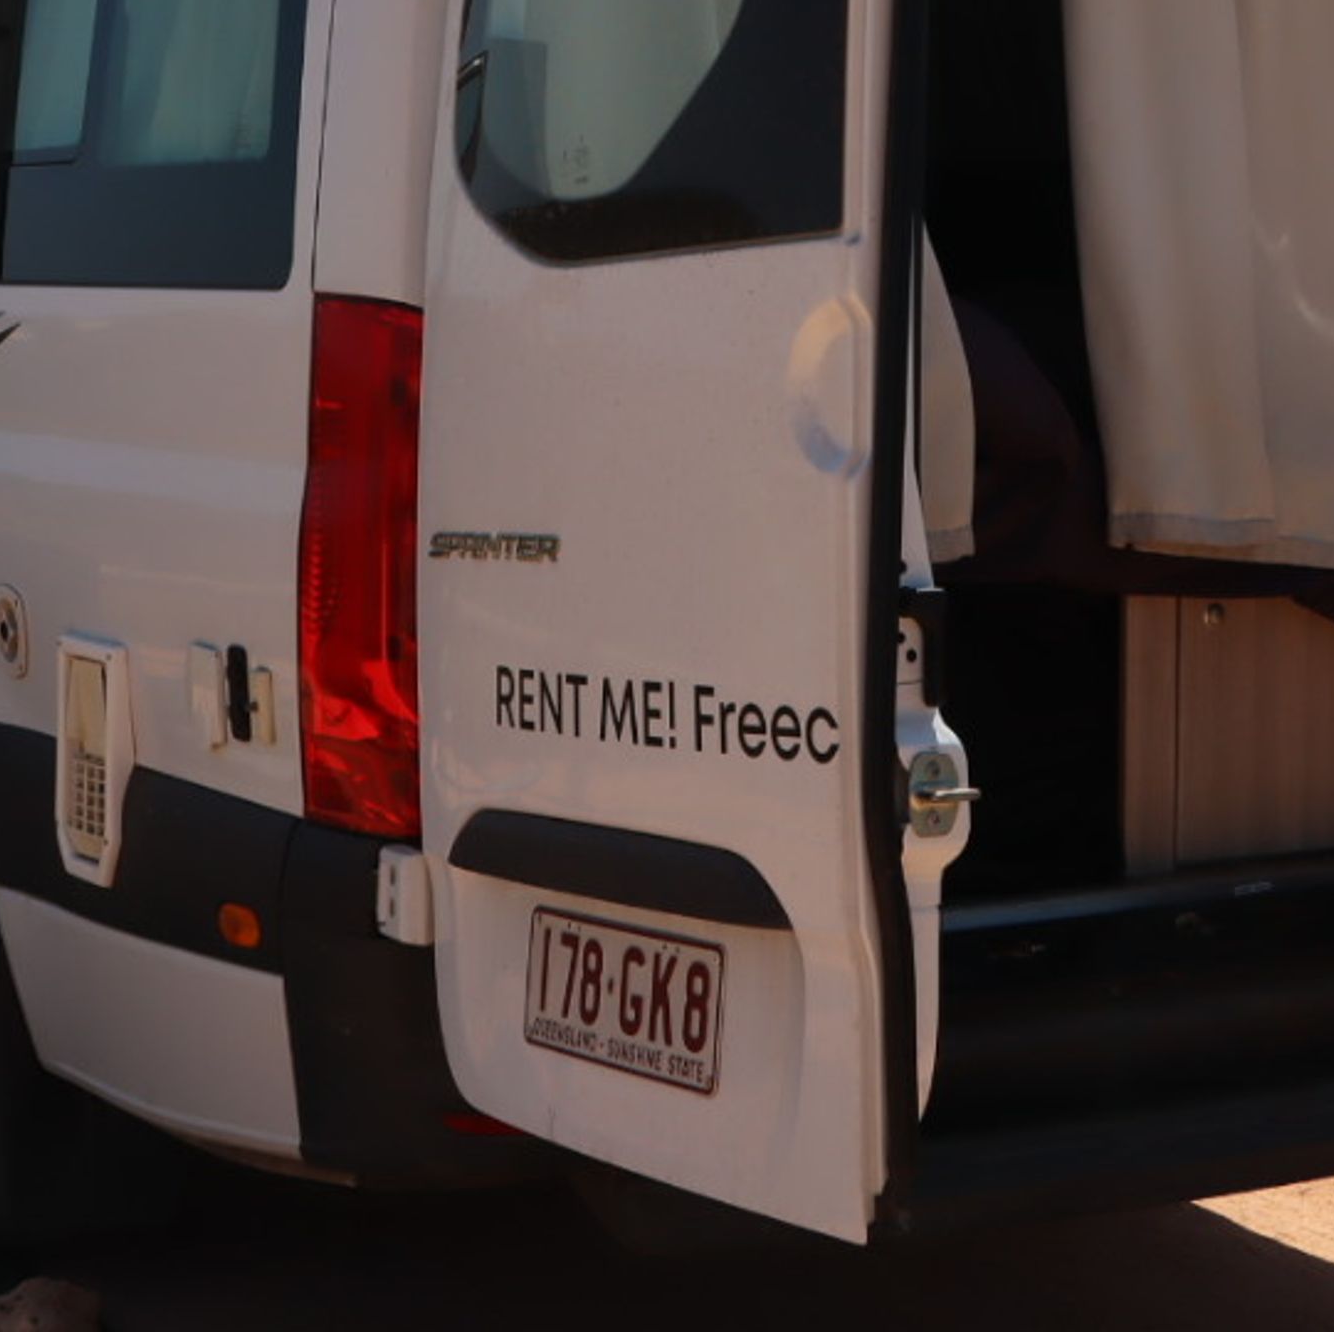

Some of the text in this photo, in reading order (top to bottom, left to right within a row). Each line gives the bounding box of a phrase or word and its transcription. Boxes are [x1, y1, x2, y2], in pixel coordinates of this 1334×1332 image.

[429, 531, 560, 562] SPRINTER
[496, 665, 840, 764] RENT ME! Freec
